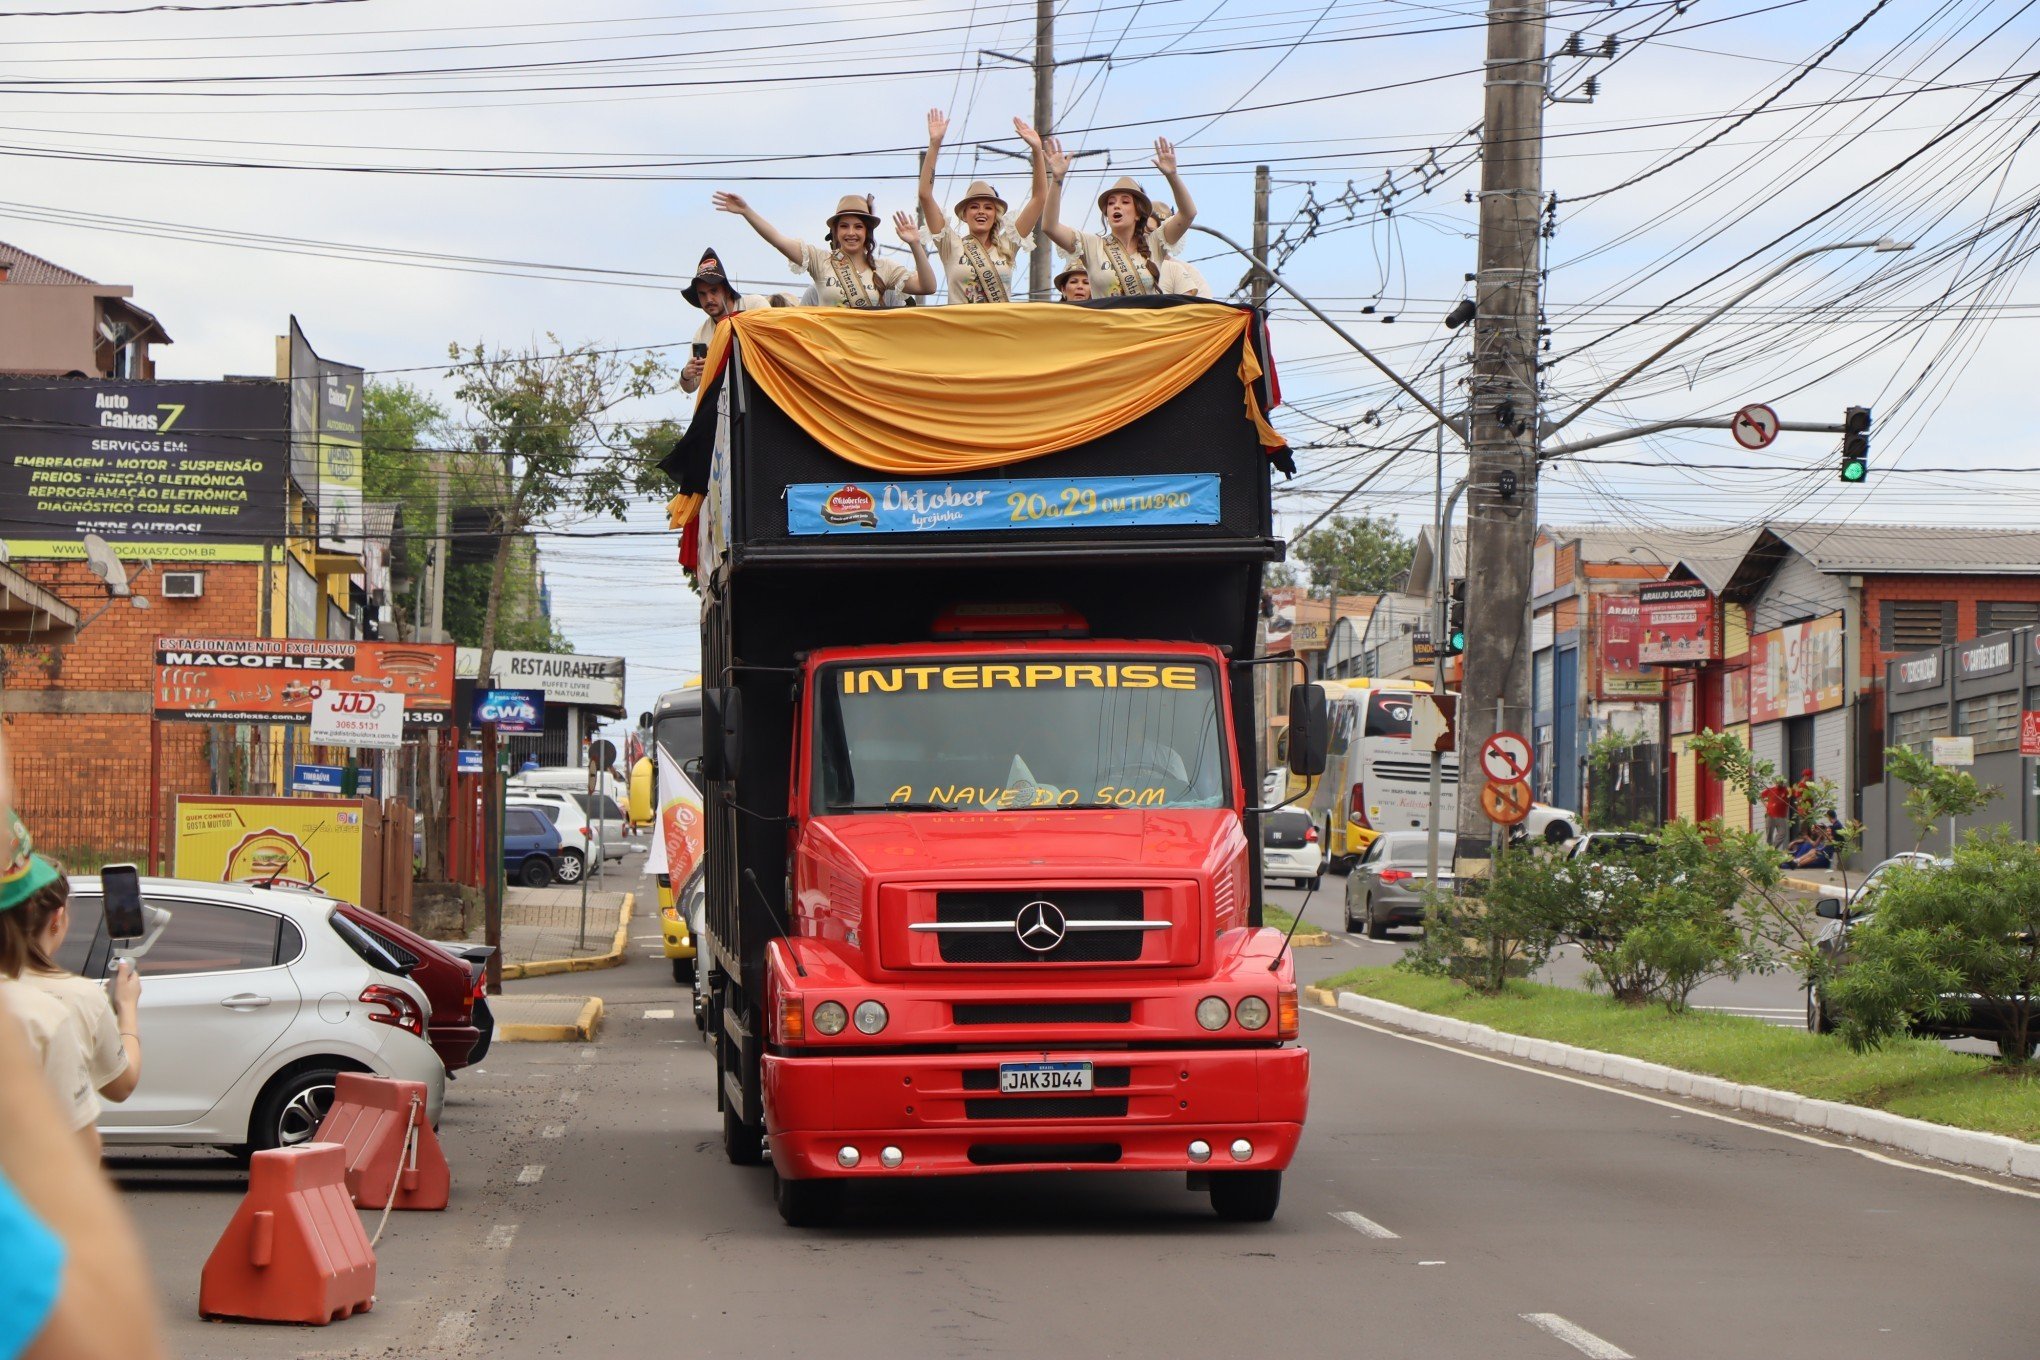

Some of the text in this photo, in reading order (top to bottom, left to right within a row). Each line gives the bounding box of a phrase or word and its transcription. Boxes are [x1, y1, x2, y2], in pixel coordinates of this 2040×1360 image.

[95, 392, 129, 409] Auto
[100, 403, 185, 436] Caixas 7
[91, 440, 188, 454] SERVIÇOS EM:
[13, 455, 105, 468] EMBREAGEM
[116, 458, 168, 471] MOTOR
[179, 458, 264, 472] SUSPENSÃO
[31, 471, 82, 483] FREIOS
[94, 472, 156, 487] INJEÇÃO
[158, 473, 245, 486] ELETRÔNICA
[28, 486, 248, 501] REPROGRAMAÇÃO ELETRÔNICA
[832, 496, 869, 505] Oktoberfest
[883, 484, 990, 513] Oktober
[1101, 491, 1192, 513] OUTUBRO
[37, 500, 240, 515] DIAGNÓSTICO COM SCANNER
[76, 521, 128, 534] ENTRE
[911, 511, 965, 531] Igrejinha
[1642, 587, 1706, 601] ARAUJO LOCAÇÕES
[159, 638, 357, 656] ESTACIONAMENTO EXCLUSIVO
[165, 652, 345, 670] MACOFLEX
[511, 657, 608, 680] RESTAURANTE
[541, 681, 590, 690] BUFFET LIVRE
[843, 664, 1197, 694] INTERPRISE
[331, 692, 375, 714] JJD
[555, 690, 590, 699] NATURAL
[185, 711, 307, 722] www.macoflexsc.com.br
[302, 771, 331, 782] TIMBAÚVA
[890, 784, 1165, 806] A NAVE DO SOM
[186, 821, 206, 830] GOSTA
[1008, 1071, 1083, 1089] JAK3D44
